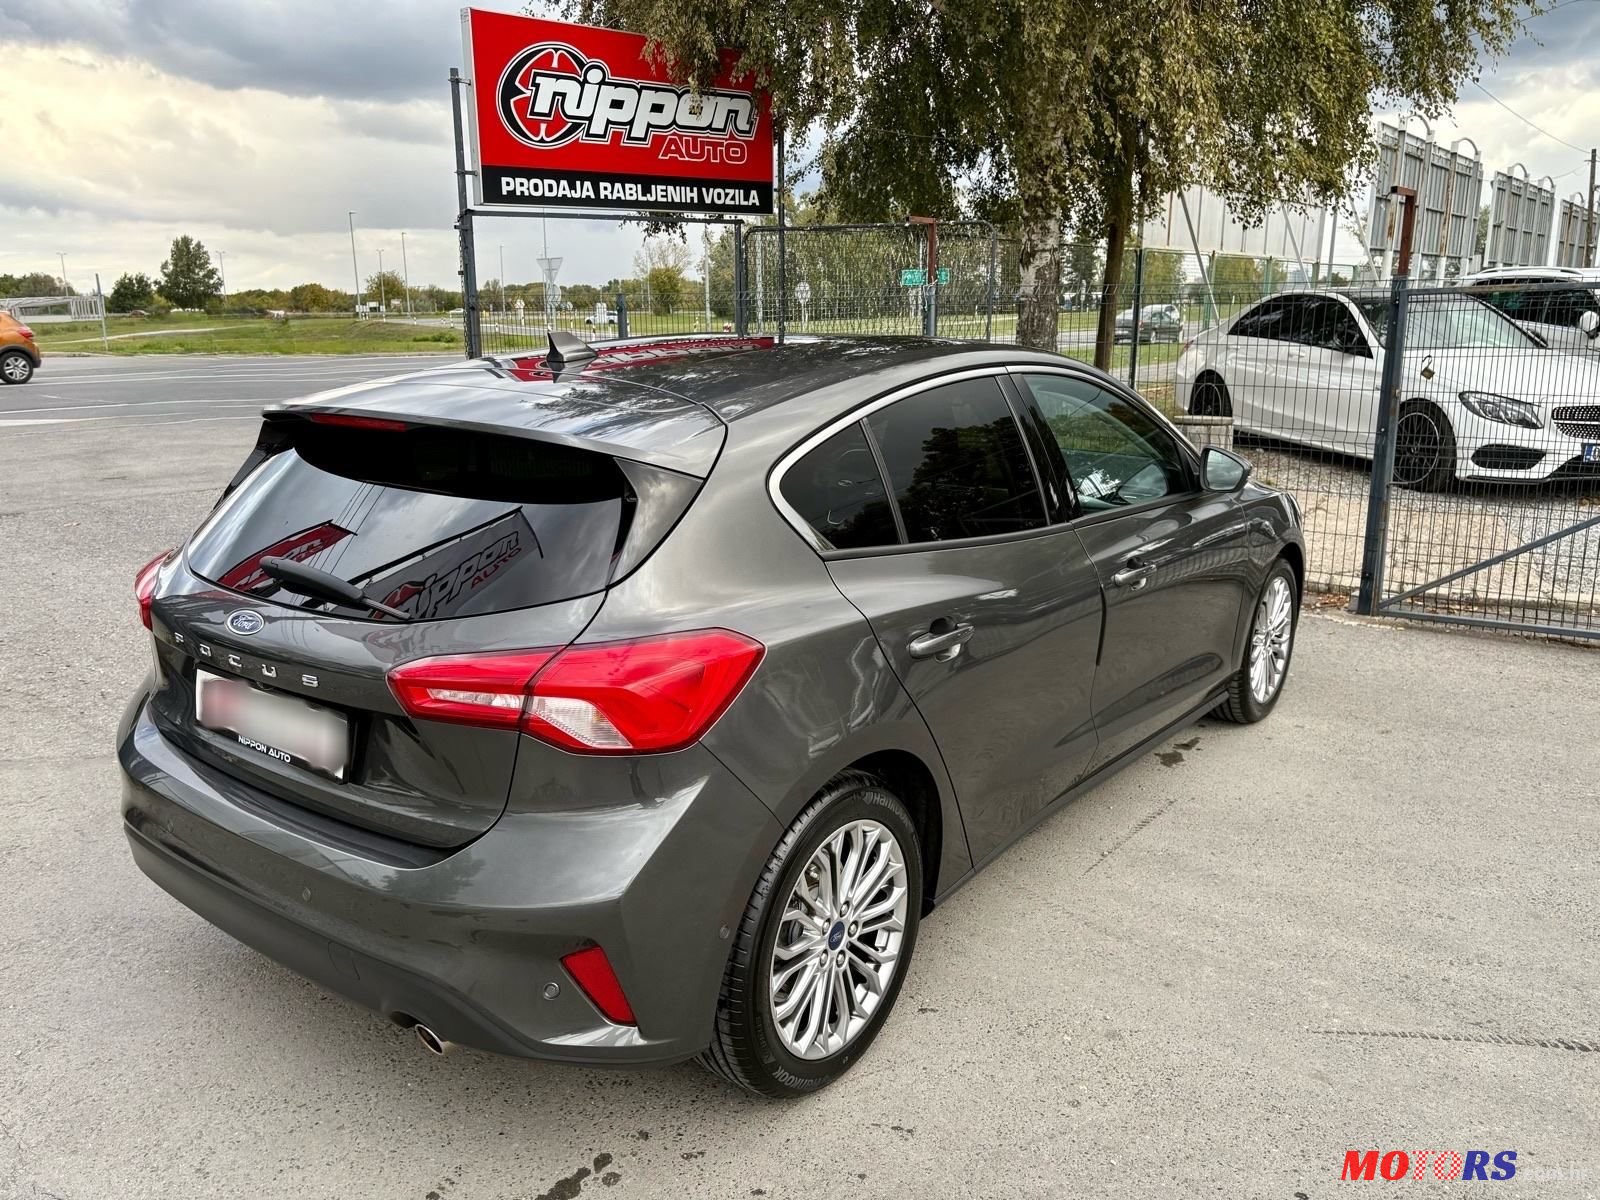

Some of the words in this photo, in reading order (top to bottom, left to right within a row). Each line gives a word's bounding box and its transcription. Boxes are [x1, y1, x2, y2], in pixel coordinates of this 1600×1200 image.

[531, 64, 757, 140] nippon
[658, 135, 748, 165] AUTO
[501, 176, 595, 200] PRODAJA
[600, 181, 698, 204] RABLJENIH
[701, 187, 760, 207] VOZILA
[471, 547, 523, 591] AUTO
[233, 613, 257, 631] Ford
[174, 631, 319, 688] FOCUS
[238, 734, 267, 754] NIPPON
[268, 747, 291, 763] AUTO
